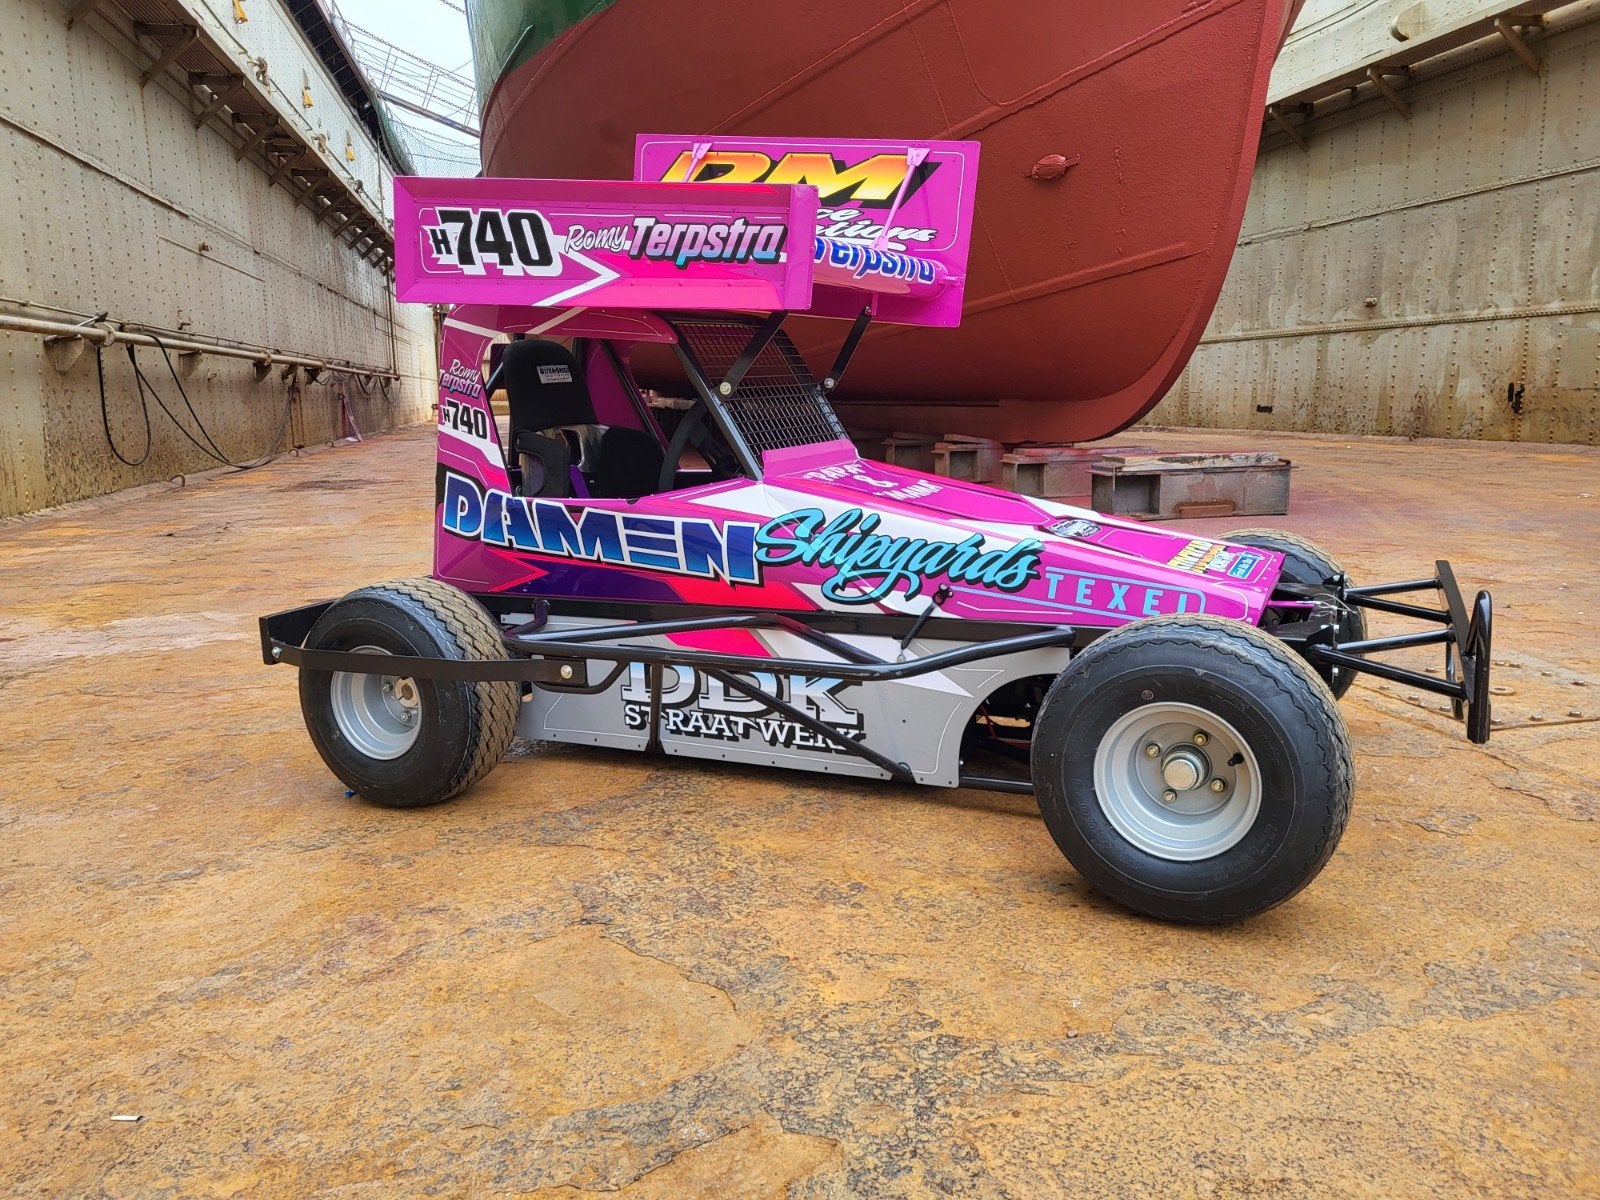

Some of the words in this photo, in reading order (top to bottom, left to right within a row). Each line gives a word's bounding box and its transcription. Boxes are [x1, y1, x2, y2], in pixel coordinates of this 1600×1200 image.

[563, 223, 629, 256] Romy
[628, 216, 786, 270] Terpstra
[439, 368, 481, 399] Terpstra
[449, 358, 481, 385] Romy
[852, 474, 899, 488] &
[442, 471, 762, 587] DAMEN
[755, 507, 1046, 606] Shipyards
